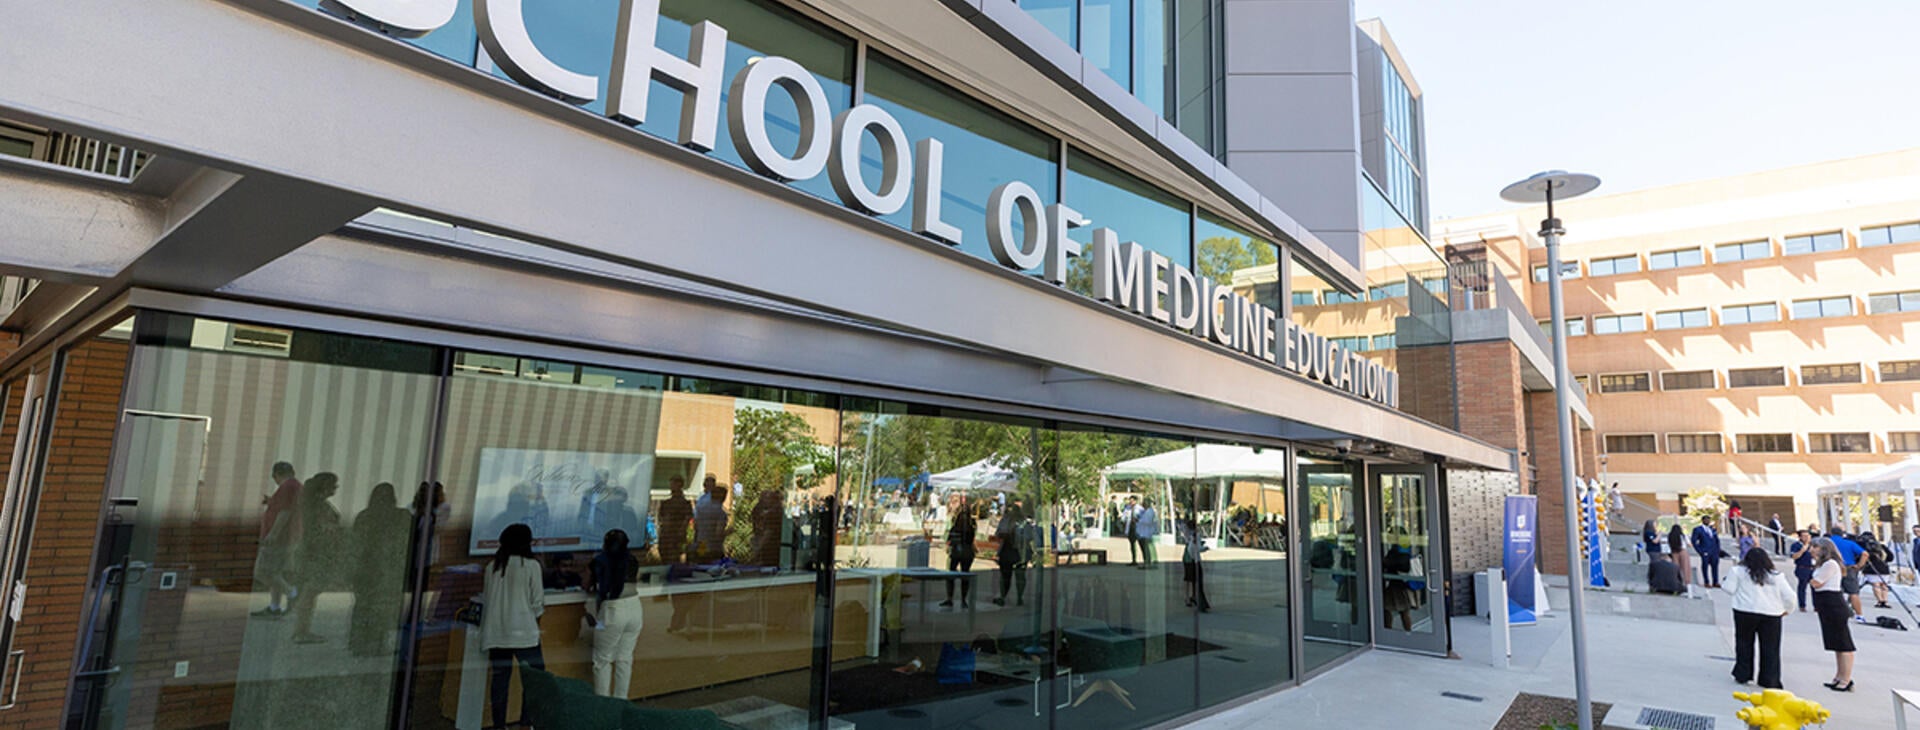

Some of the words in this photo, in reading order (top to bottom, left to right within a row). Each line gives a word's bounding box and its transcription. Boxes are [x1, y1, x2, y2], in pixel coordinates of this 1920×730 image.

[318, 0, 962, 245] CHOOL
[987, 181, 1083, 285] OF
[1093, 227, 1276, 363] MEDICINE
[1276, 318, 1388, 405] EDUCATION
